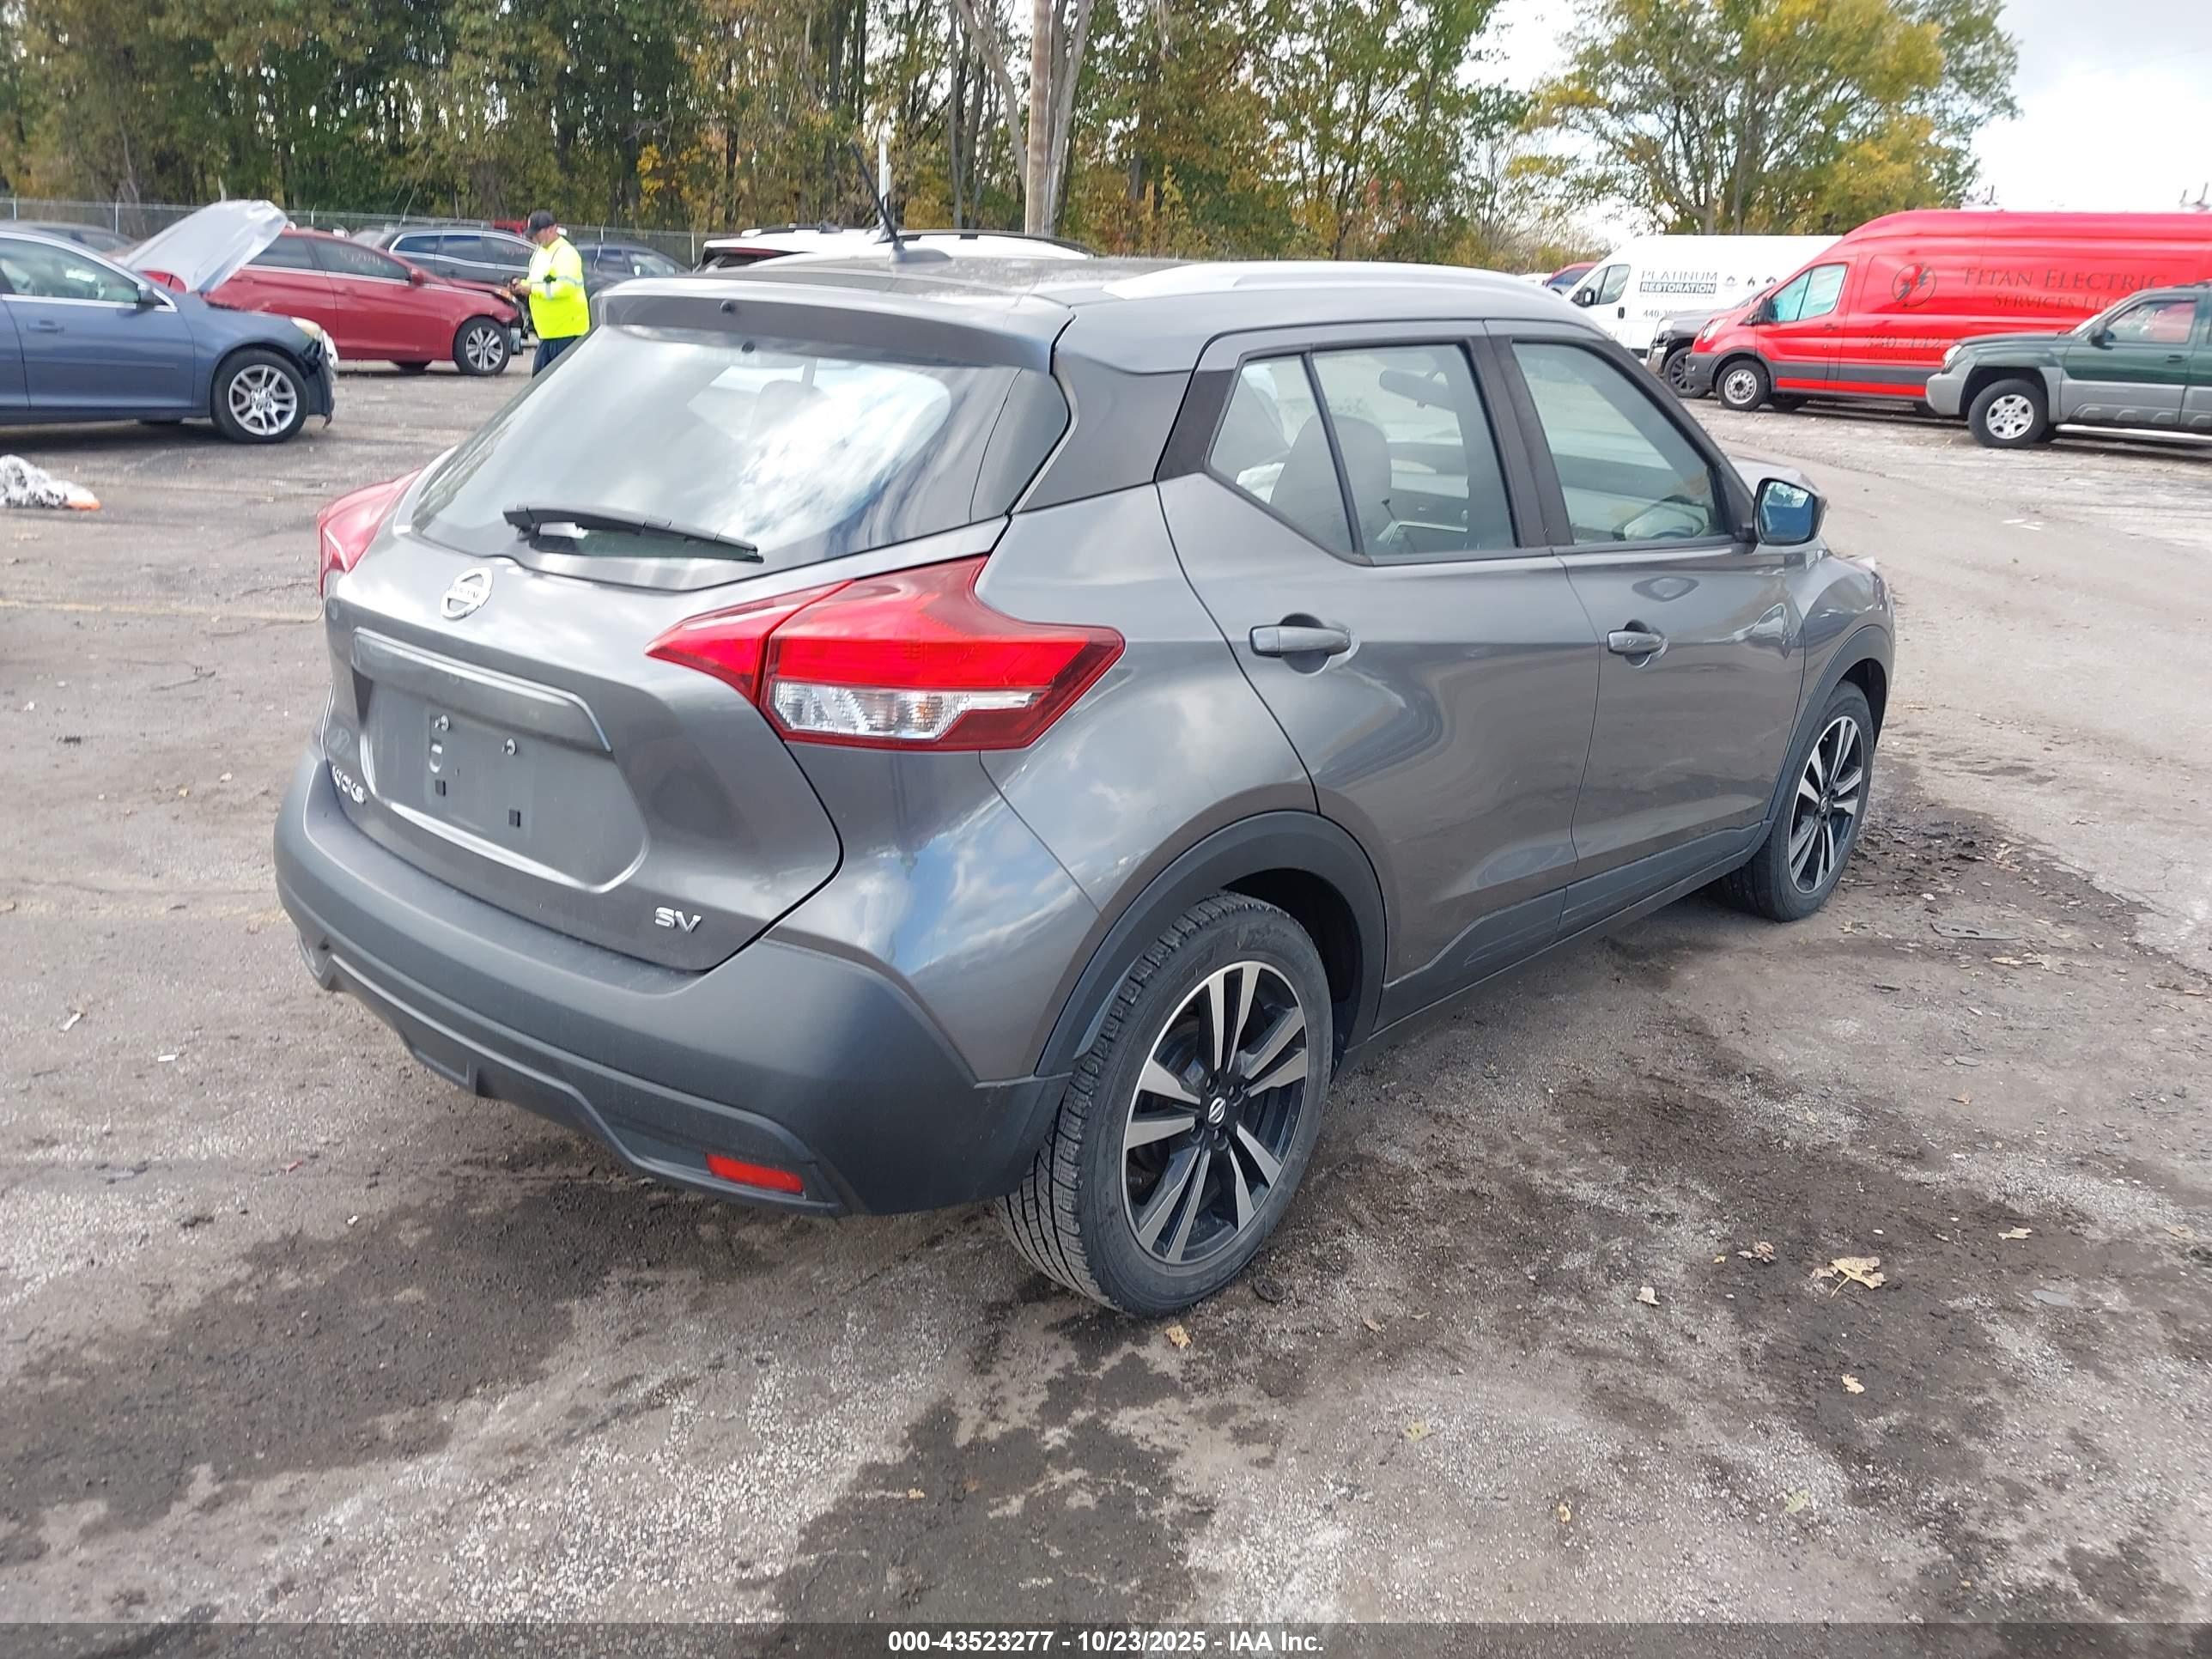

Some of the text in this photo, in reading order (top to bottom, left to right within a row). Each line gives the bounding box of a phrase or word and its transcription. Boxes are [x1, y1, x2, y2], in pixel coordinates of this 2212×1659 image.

[1641, 270, 1717, 282] PLATINUM
[1960, 266, 2166, 291] TITAN ELECTRIC
[1640, 282, 1716, 294] RESTORATION
[1992, 293, 2078, 310] SERVICES
[654, 906, 702, 934] SV
